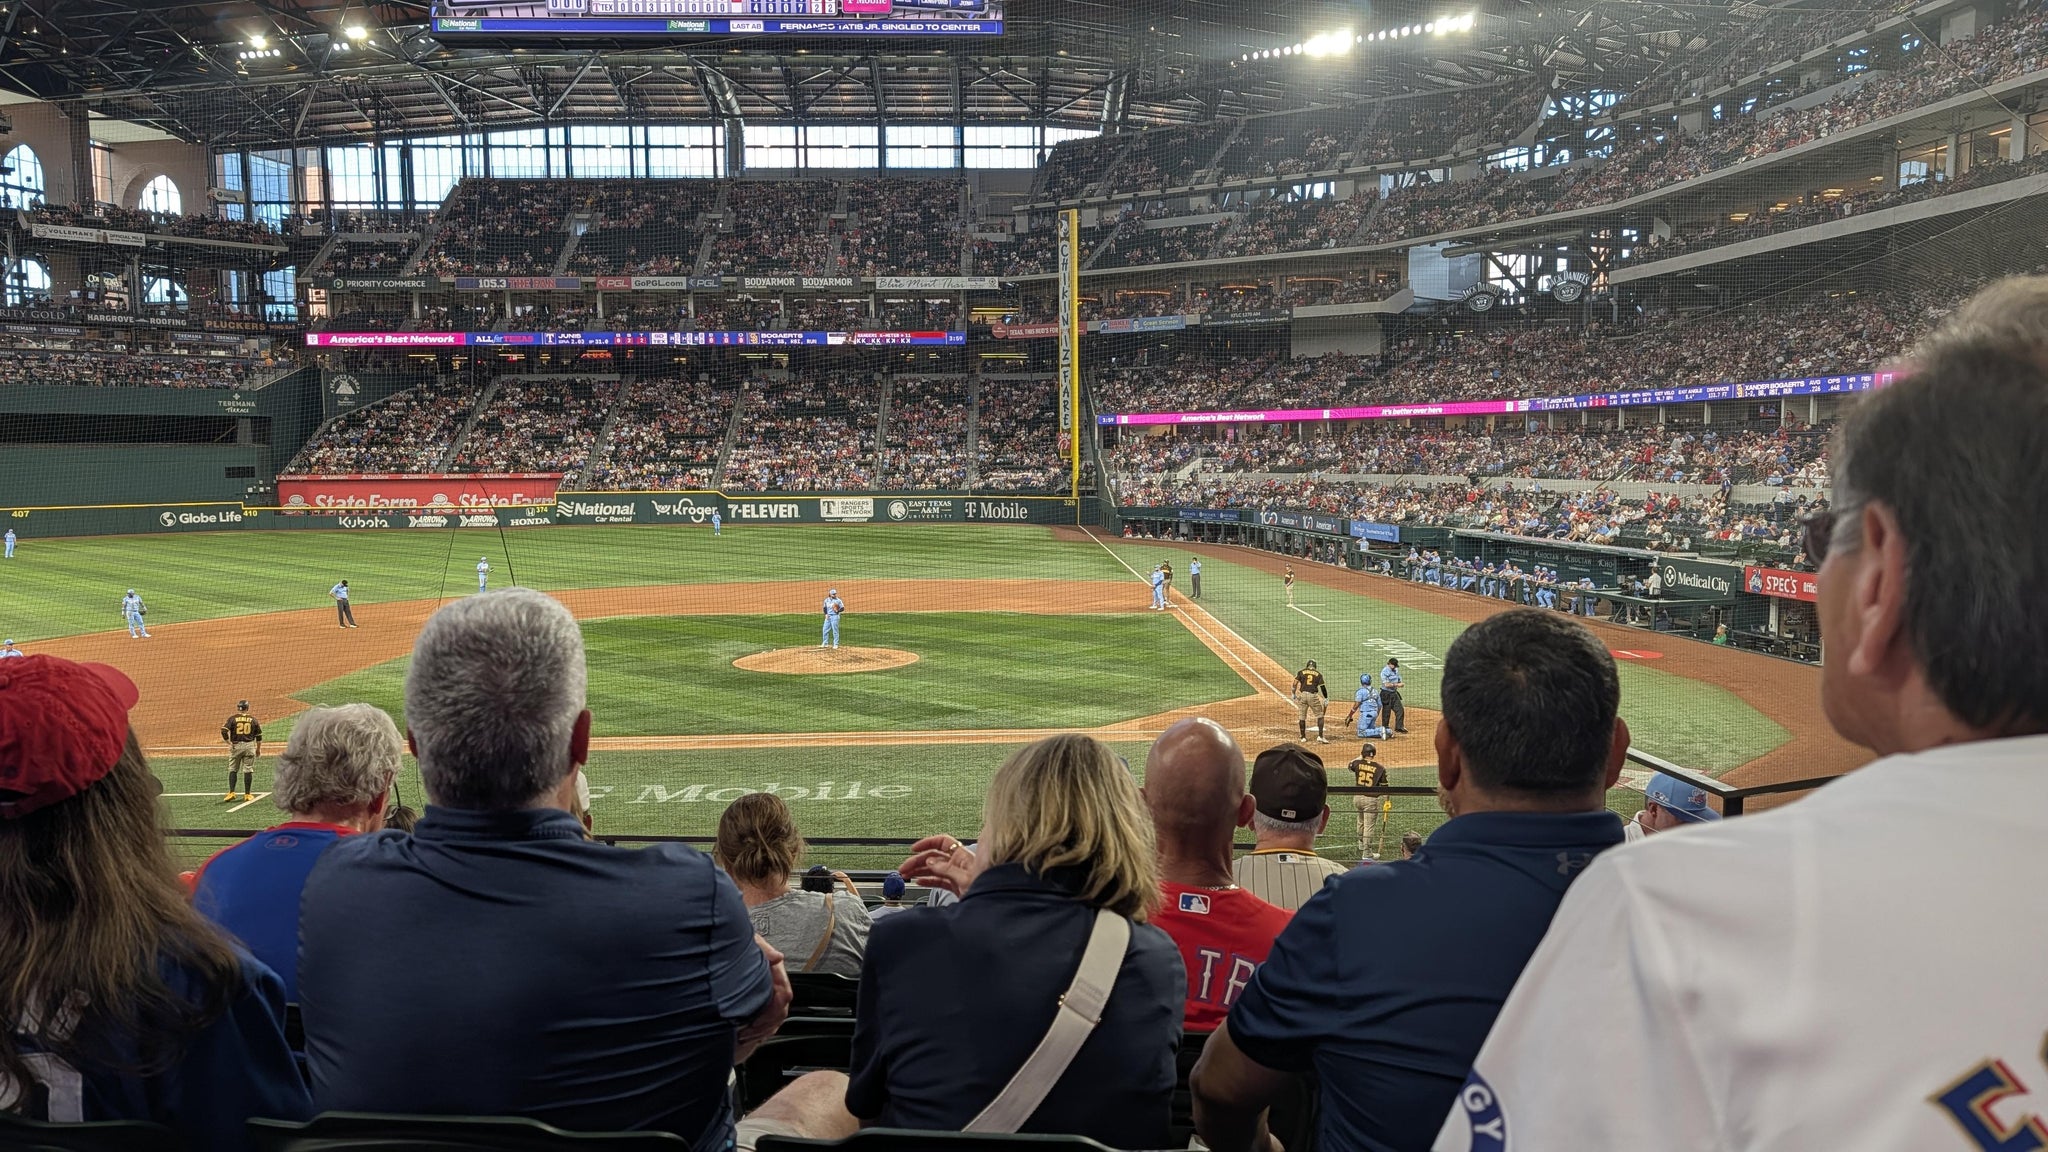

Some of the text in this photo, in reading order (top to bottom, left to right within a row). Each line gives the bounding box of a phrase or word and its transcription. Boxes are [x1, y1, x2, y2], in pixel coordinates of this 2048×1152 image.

[601, 4, 613, 12] TEX
[678, 20, 705, 28] National
[347, 280, 426, 288] PRIORITY COMMERCE
[478, 279, 506, 288] 105.3
[635, 279, 683, 288] GoPGL.com
[697, 279, 719, 287] PGL
[745, 278, 795, 287] BODYARMOR
[803, 278, 853, 287] BODYARMOR
[877, 278, 904, 289] Blue
[905, 278, 938, 289] Mint
[1061, 243, 1070, 328] CHIKIN
[31, 311, 65, 320] GOLD
[87, 314, 187, 326] HARGROVE ROOFING
[205, 320, 266, 331] PLUCKERS
[329, 335, 455, 344] America's Best Network
[476, 335, 493, 343] ALL
[1745, 380, 1805, 391] XANDER BOGAERTS
[1062, 370, 1070, 430] FARE
[1181, 412, 1265, 422] America's Best Network
[536, 506, 548, 514] 374
[574, 502, 635, 515] National
[673, 498, 718, 523] Kroger
[965, 501, 1028, 519] T Mobile
[11, 510, 30, 518] 407
[179, 511, 242, 524] Globe Life
[470, 515, 494, 523] ARROW
[339, 516, 389, 528] Kubota
[510, 517, 551, 526] HONDA
[1677, 572, 1730, 595] Medical City
[1766, 575, 1798, 594] SPEC'S
[1306, 675, 1313, 685] 2
[236, 722, 252, 735] 20
[1357, 770, 1374, 787] 25
[624, 781, 914, 804] Mobile
[1461, 1083, 1504, 1141] GY
